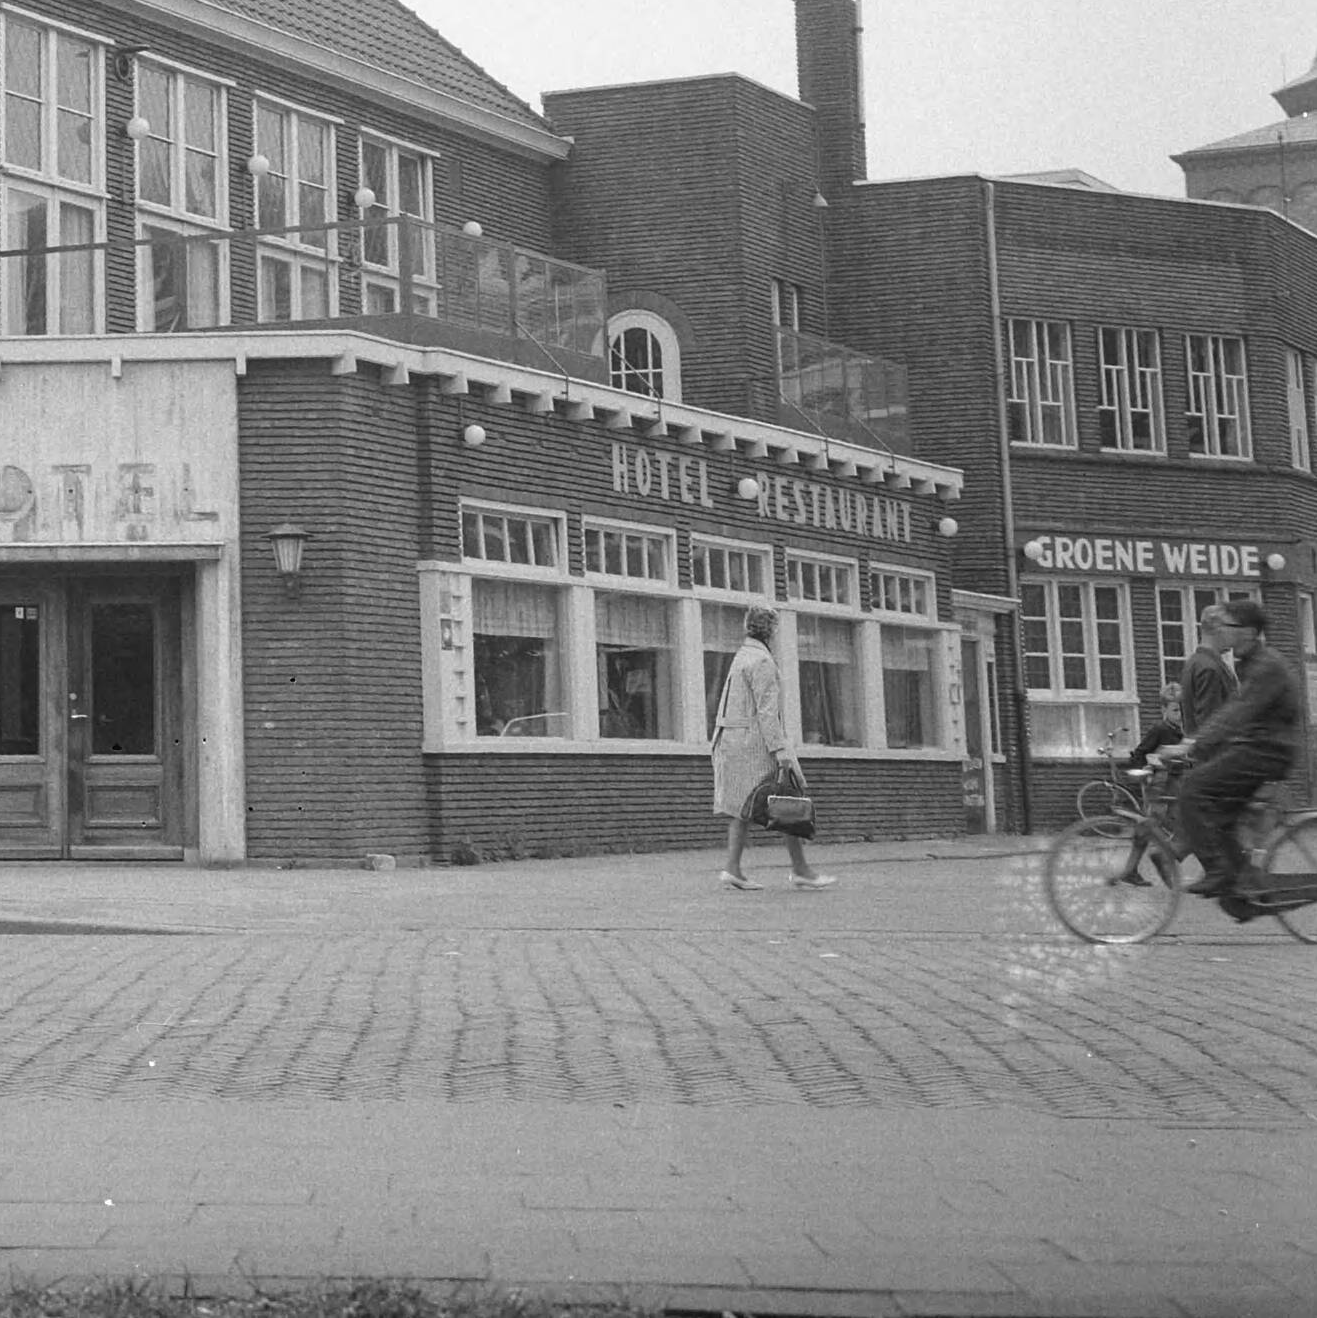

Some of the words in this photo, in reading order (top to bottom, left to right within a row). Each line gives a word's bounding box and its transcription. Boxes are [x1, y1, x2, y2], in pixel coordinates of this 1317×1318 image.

[612, 442, 714, 509] HOTEL
[756, 472, 912, 544] RESTAURANT
[1036, 536, 1156, 573] GROENE
[1162, 543, 1261, 577] WEIDE
